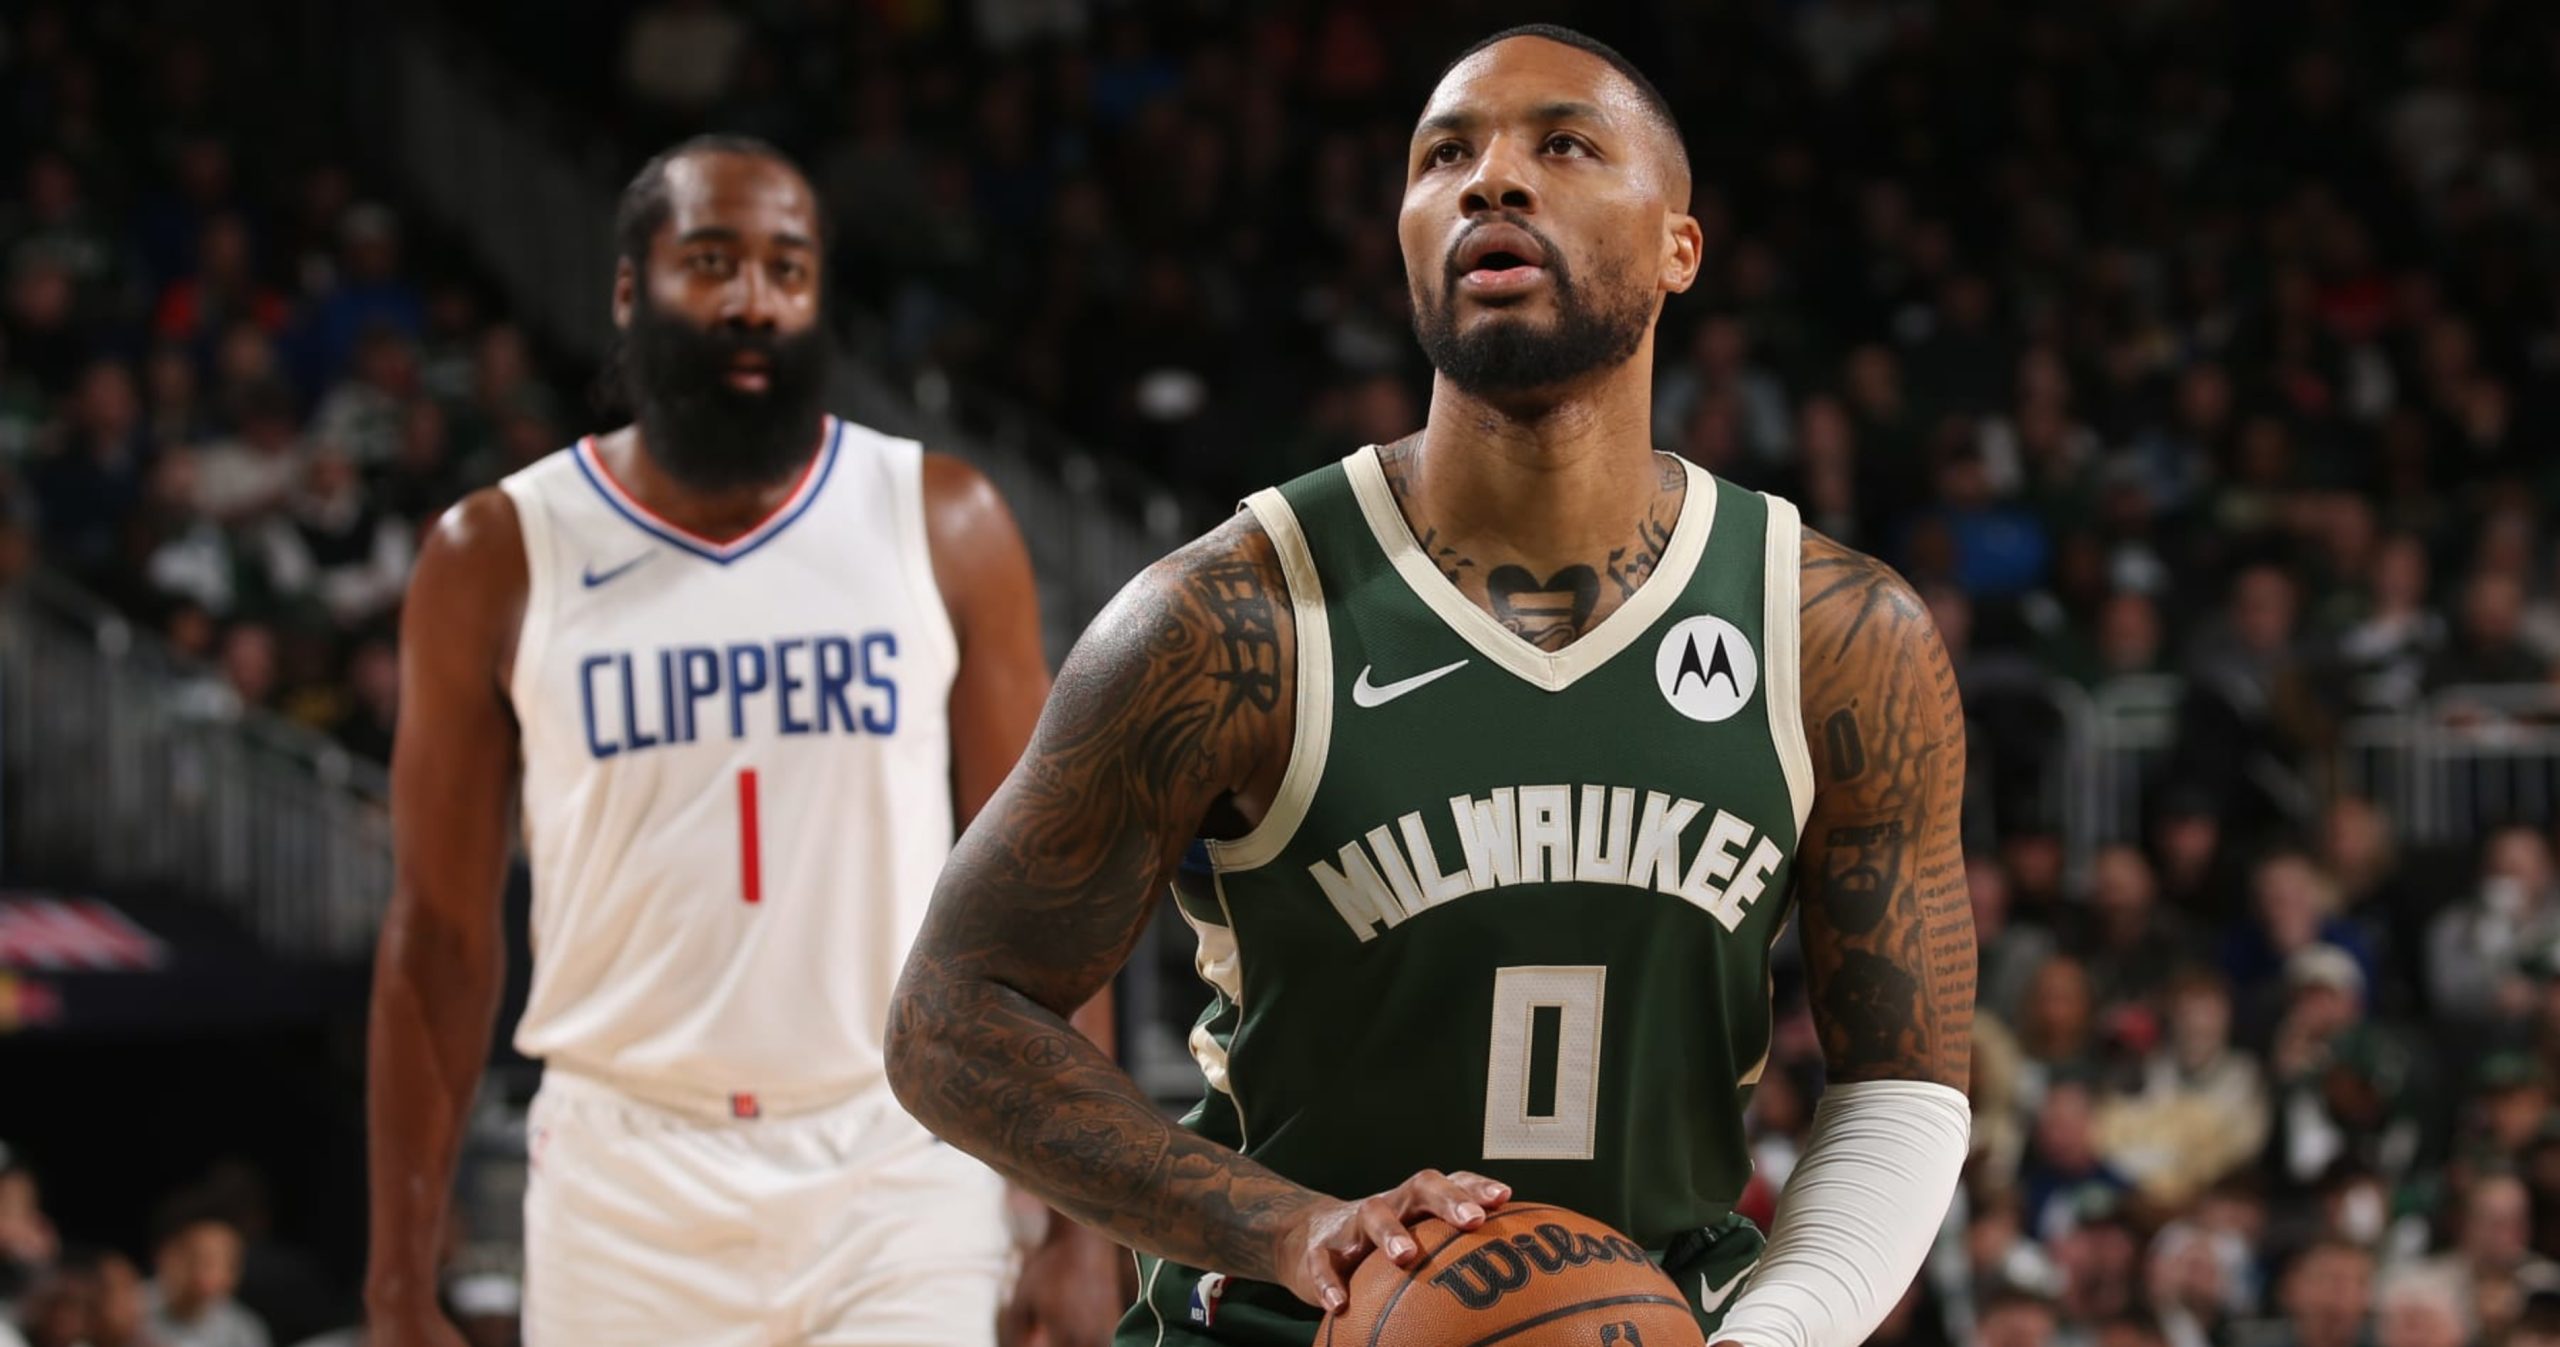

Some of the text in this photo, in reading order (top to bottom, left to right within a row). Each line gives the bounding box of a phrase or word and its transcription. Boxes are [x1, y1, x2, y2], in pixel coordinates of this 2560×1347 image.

[578, 630, 900, 760] CLIPPERS
[737, 768, 763, 904] 1
[1307, 784, 1784, 943] MILWAUKEE
[1483, 965, 1607, 1160] 0
[1190, 1306, 1204, 1322] NBA
